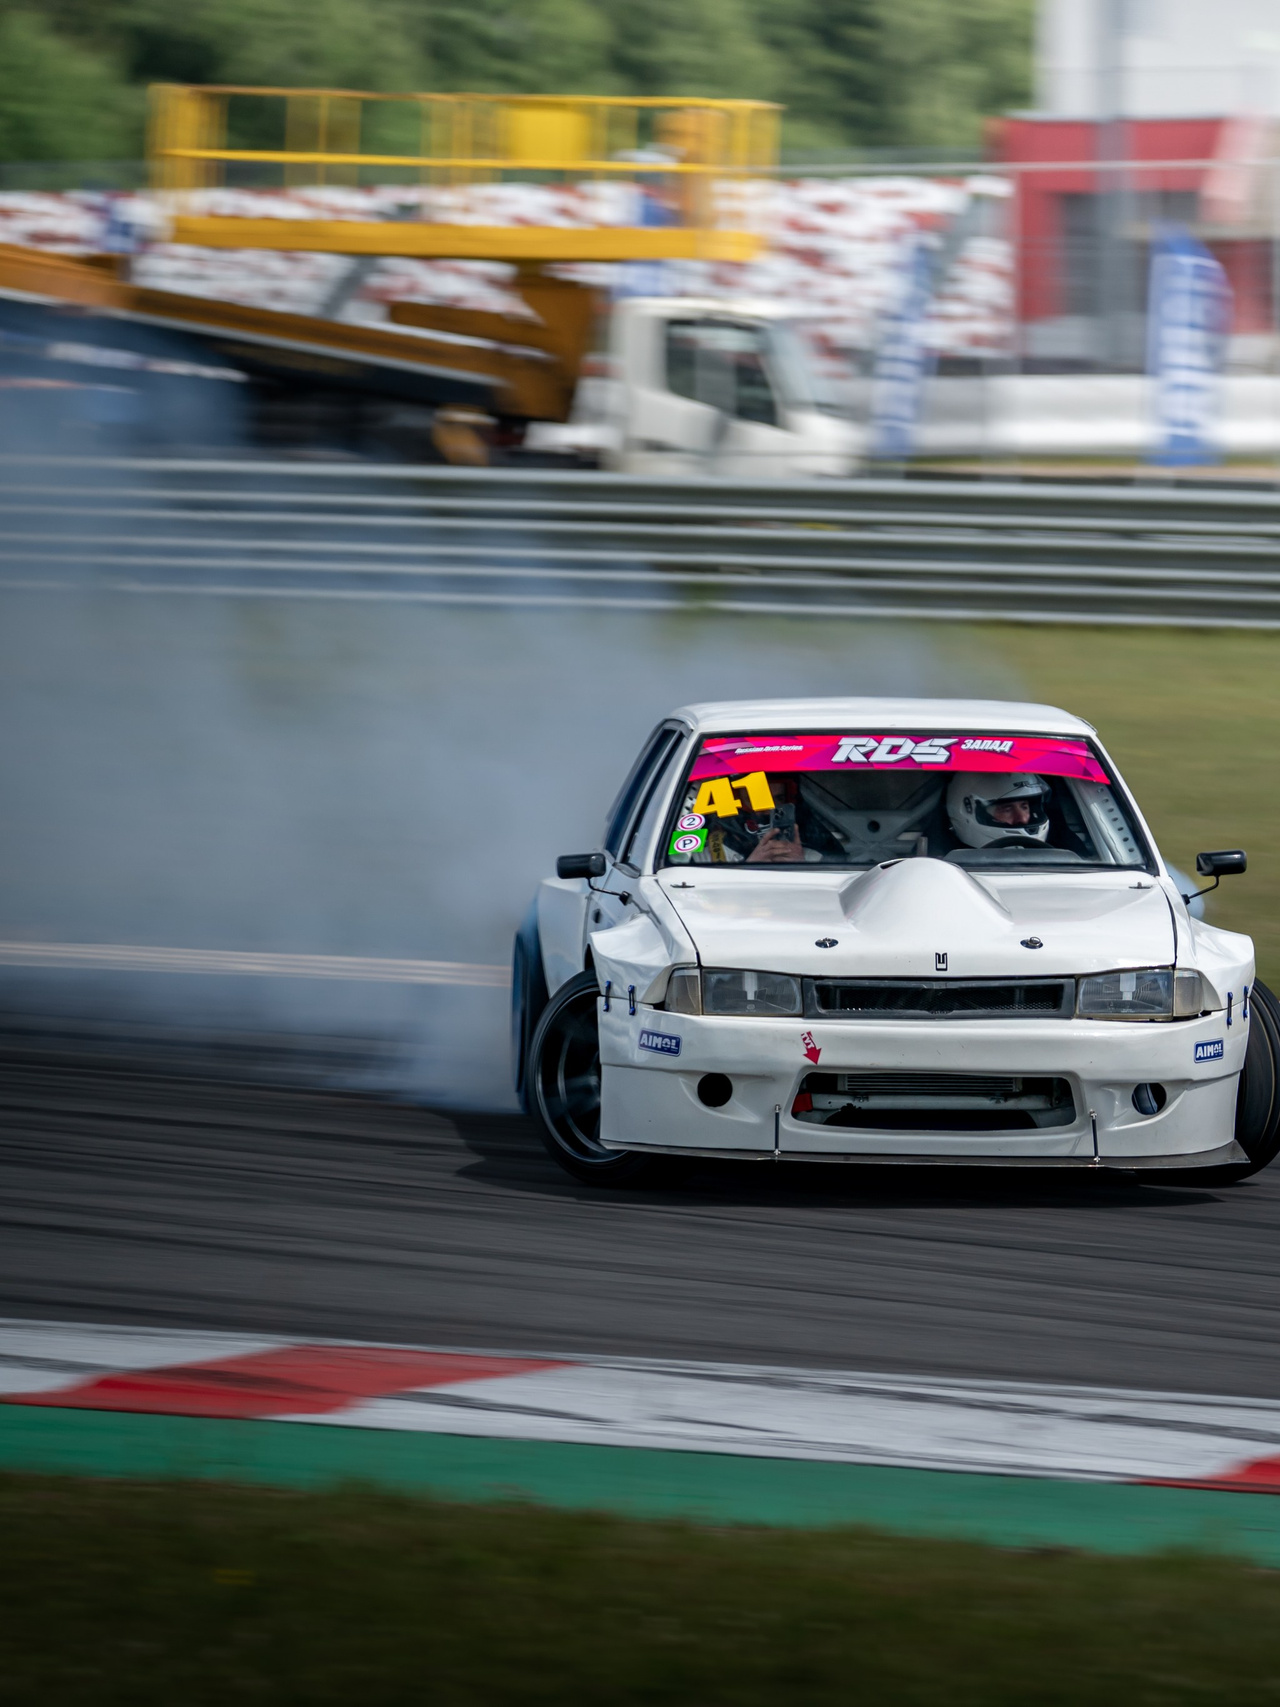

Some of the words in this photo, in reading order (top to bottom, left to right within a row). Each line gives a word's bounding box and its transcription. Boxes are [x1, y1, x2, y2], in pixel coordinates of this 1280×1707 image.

[831, 737, 959, 763] RDS
[961, 739, 1013, 753] ЗАПАД
[692, 771, 775, 818] 41
[640, 1033, 679, 1050] AIMOL
[1196, 1043, 1222, 1058] AIMOL
